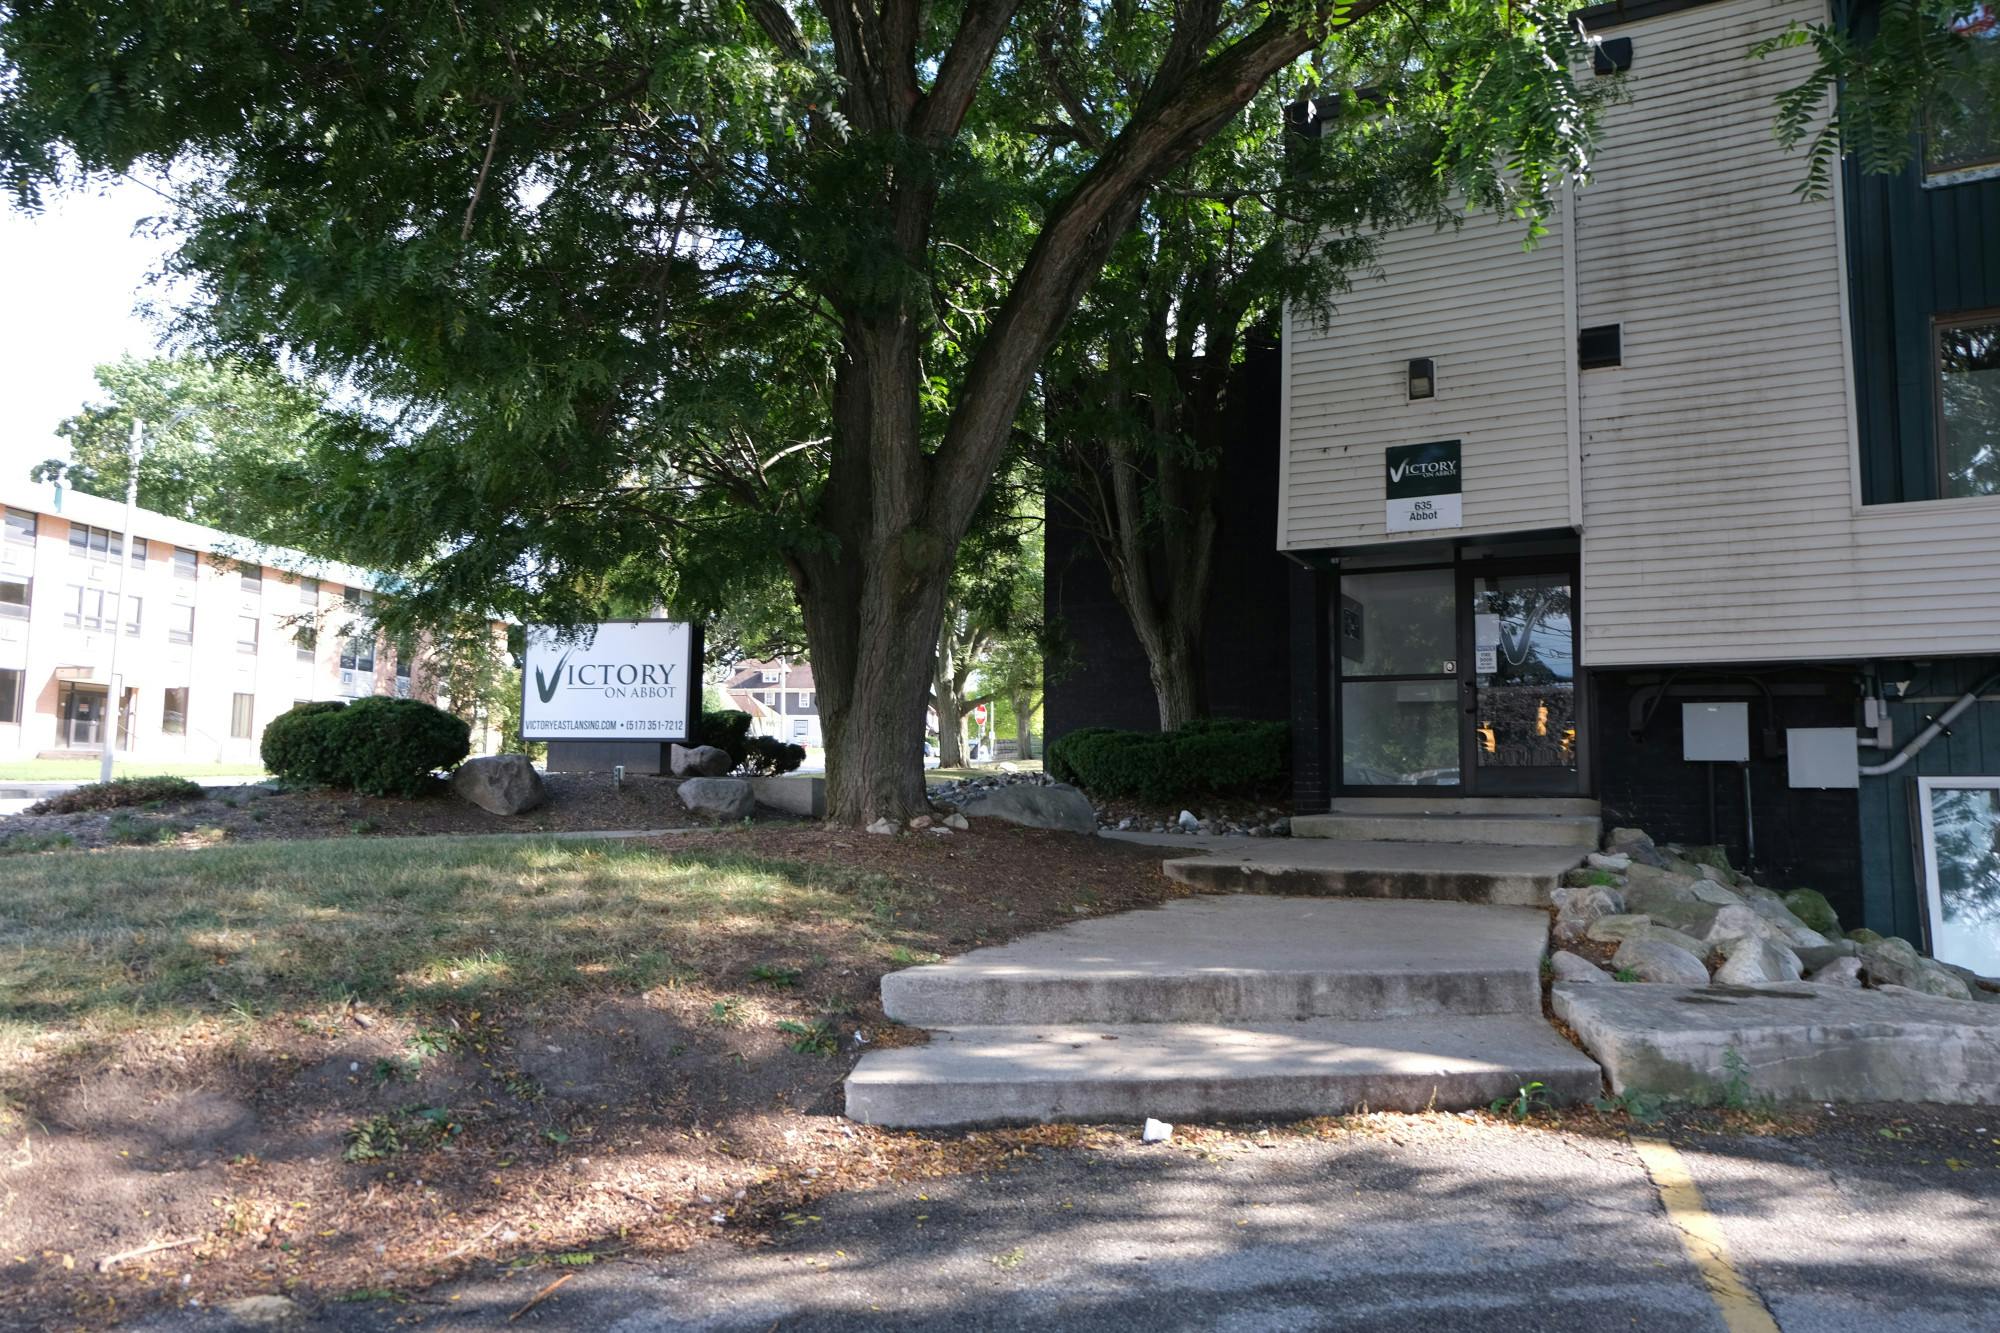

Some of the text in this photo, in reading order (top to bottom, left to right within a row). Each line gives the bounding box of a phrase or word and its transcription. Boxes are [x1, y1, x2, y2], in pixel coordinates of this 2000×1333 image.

[1390, 458, 1456, 483] VICTORY
[1414, 501, 1432, 511] 635
[1409, 511, 1438, 521] Abbot
[535, 647, 676, 703] VICTORY
[604, 686, 676, 698] ON ABBOT
[525, 720, 683, 731] VICTORYEASTLANSING.COM (517) 351-7212
